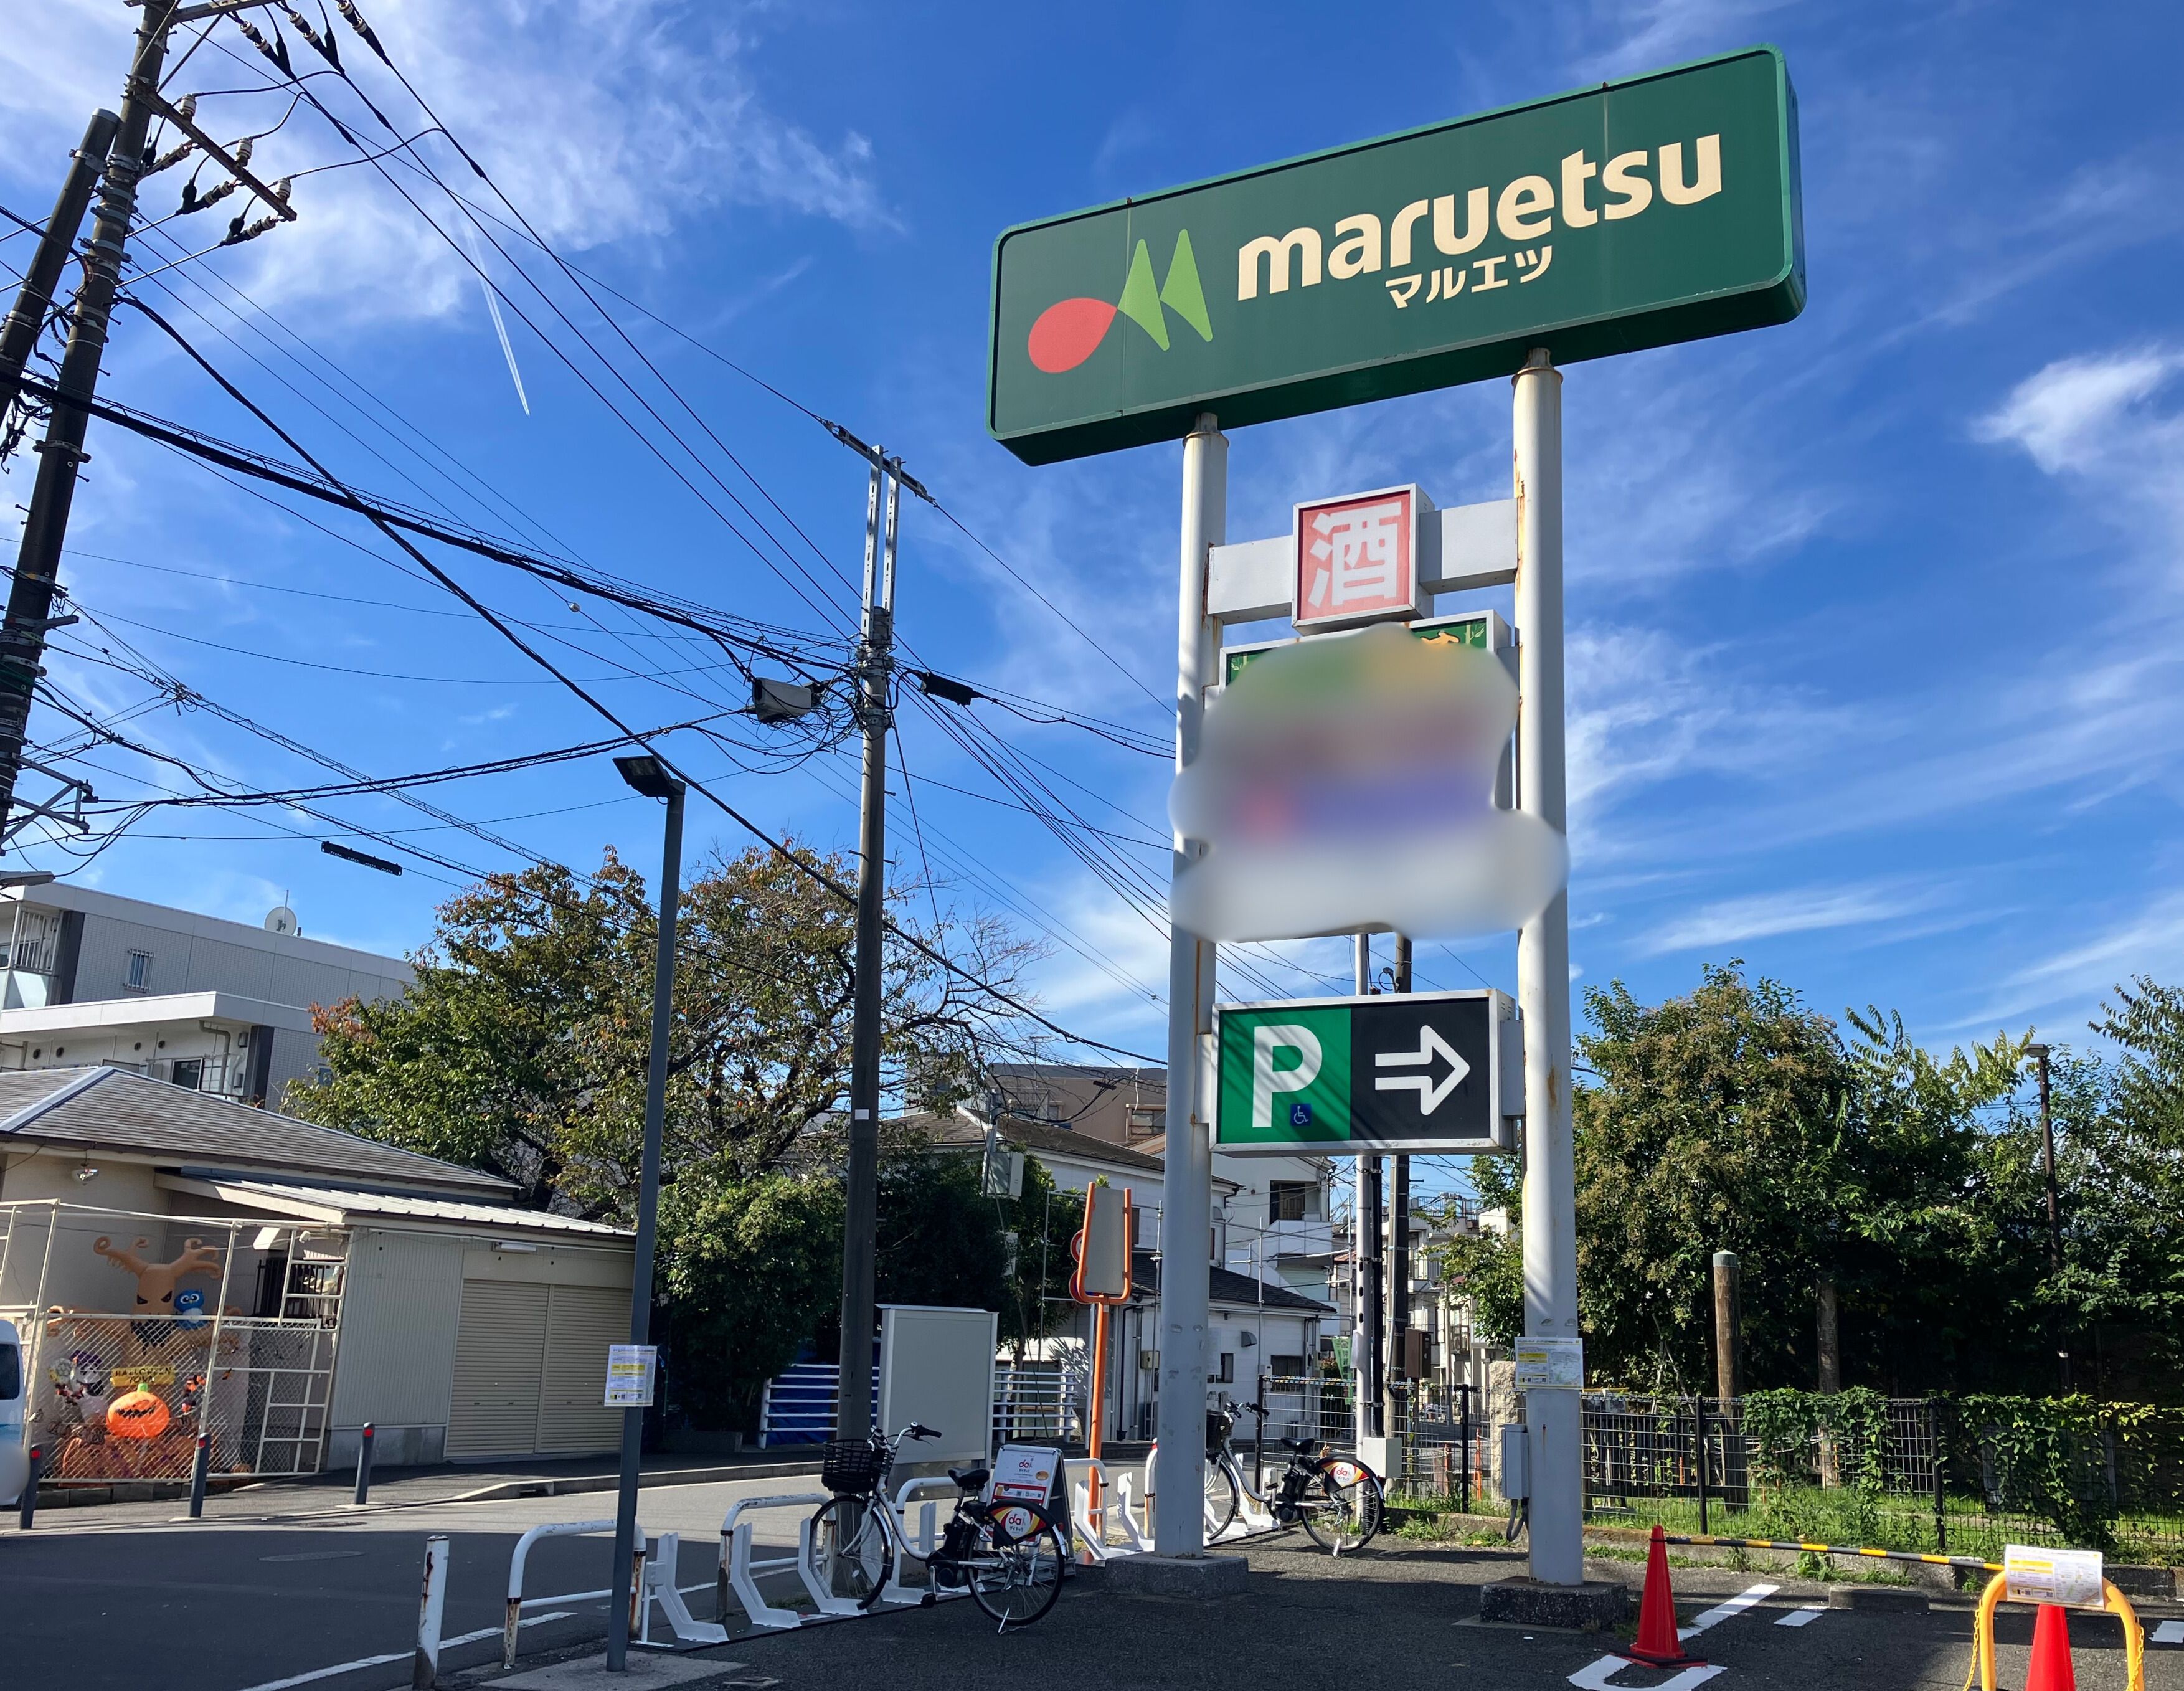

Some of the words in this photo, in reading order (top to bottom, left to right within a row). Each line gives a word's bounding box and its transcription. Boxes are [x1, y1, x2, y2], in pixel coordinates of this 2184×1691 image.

[1238, 134, 1722, 300] maruetsu
[1386, 246, 1552, 309] マルエツ
[1308, 500, 1407, 609] 酒
[1252, 1025, 1323, 1128] P
